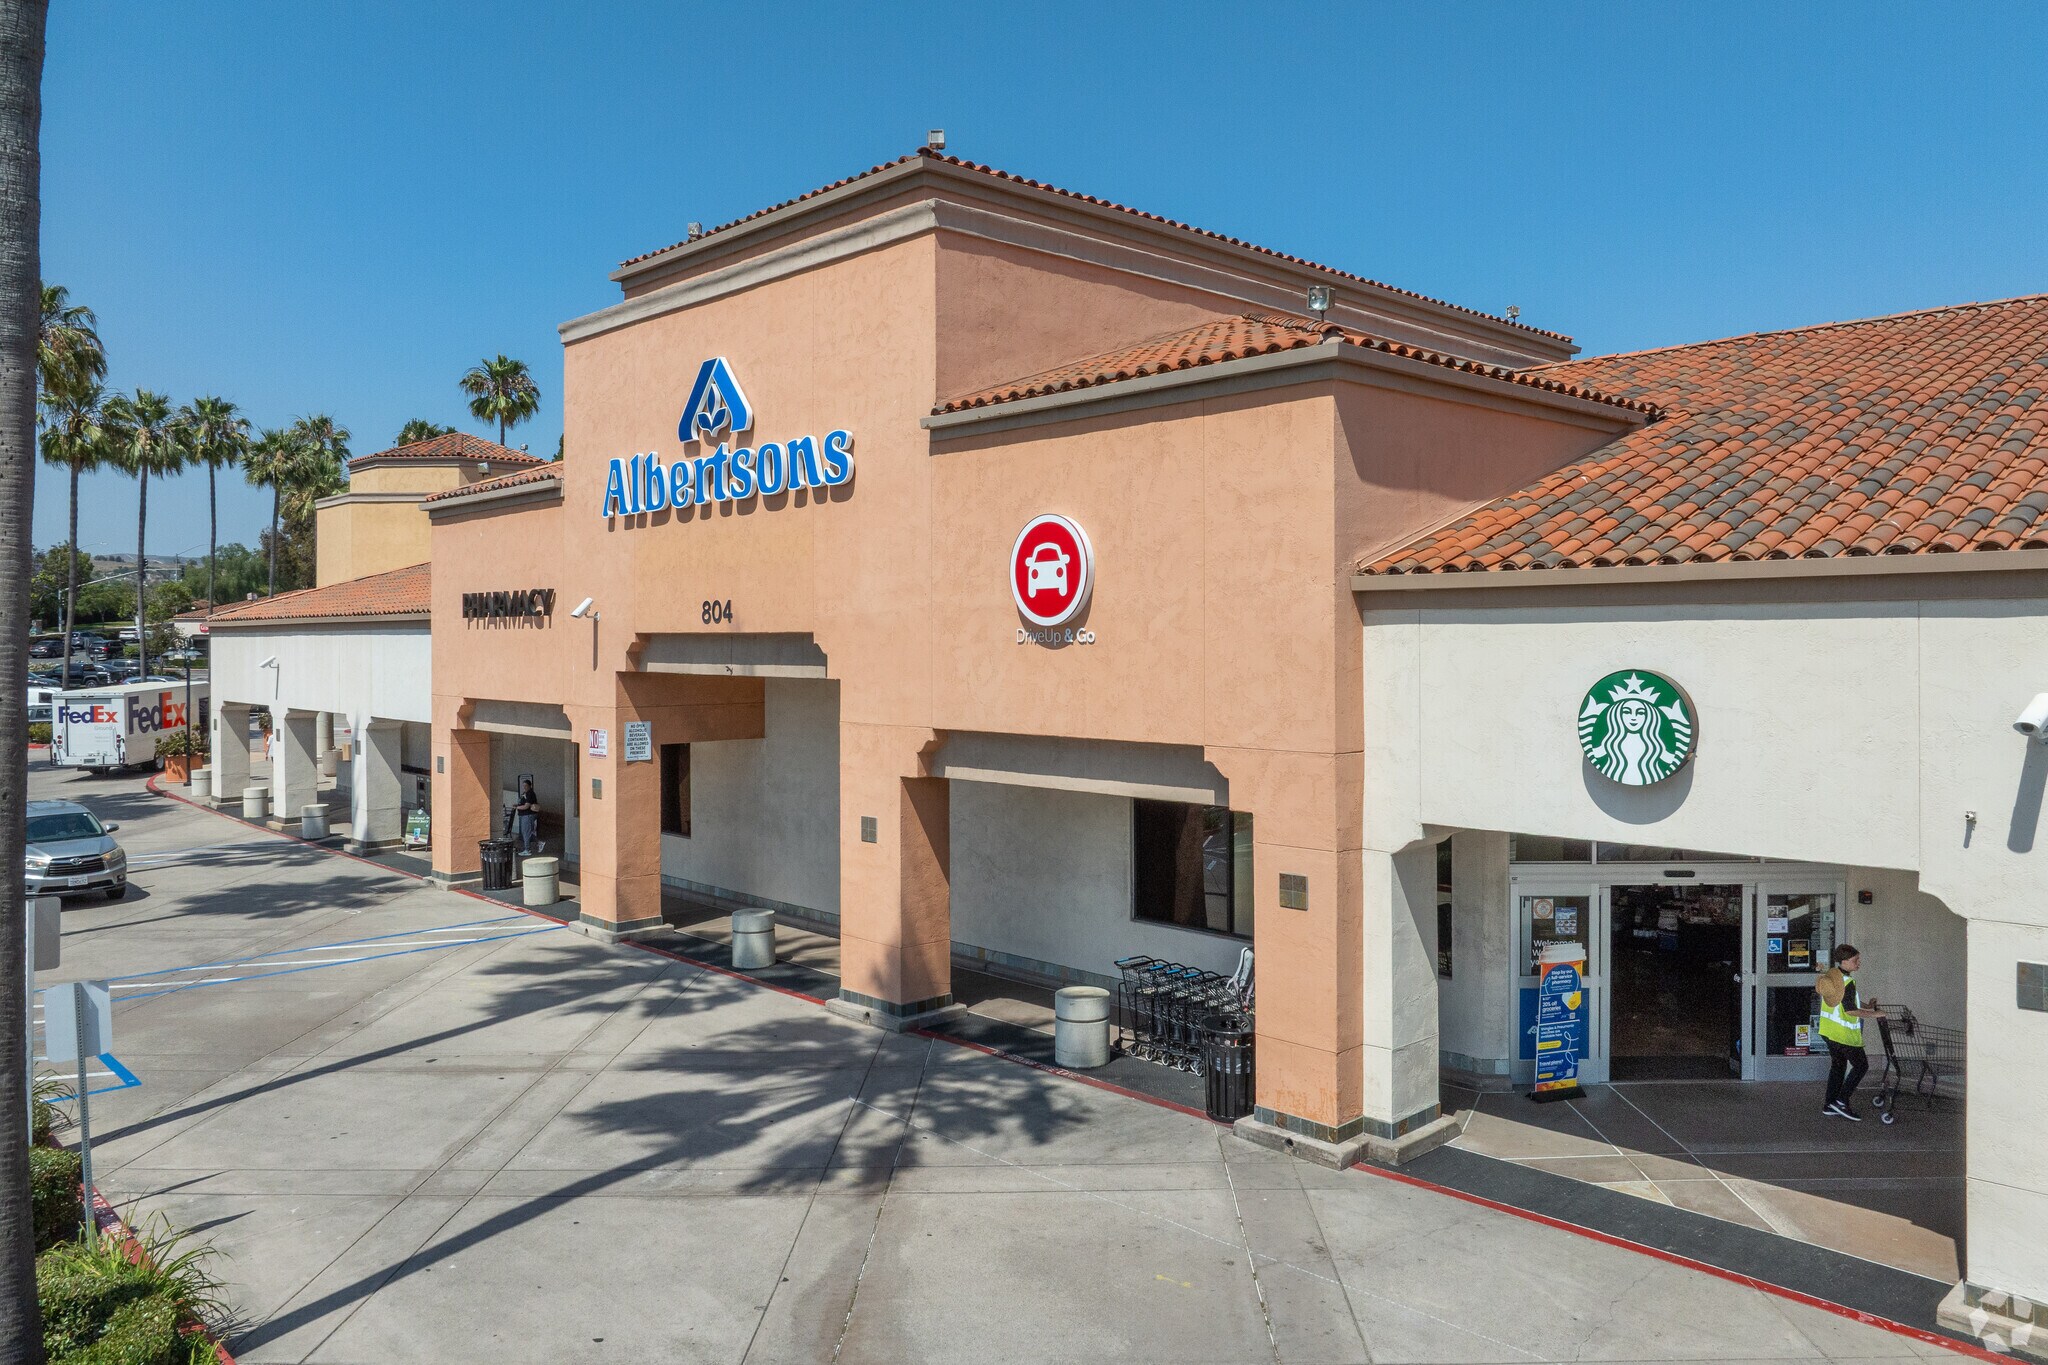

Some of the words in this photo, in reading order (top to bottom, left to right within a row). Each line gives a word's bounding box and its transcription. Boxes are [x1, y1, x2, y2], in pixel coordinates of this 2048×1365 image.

[602, 430, 853, 518] Albertsons
[462, 588, 555, 618] PHARMACY
[701, 600, 733, 624] 804
[1016, 628, 1061, 646] DriveUp
[1064, 628, 1074, 643] &
[1076, 627, 1096, 643] Go
[58, 705, 118, 724] FedEx
[128, 691, 187, 735] FedEx
